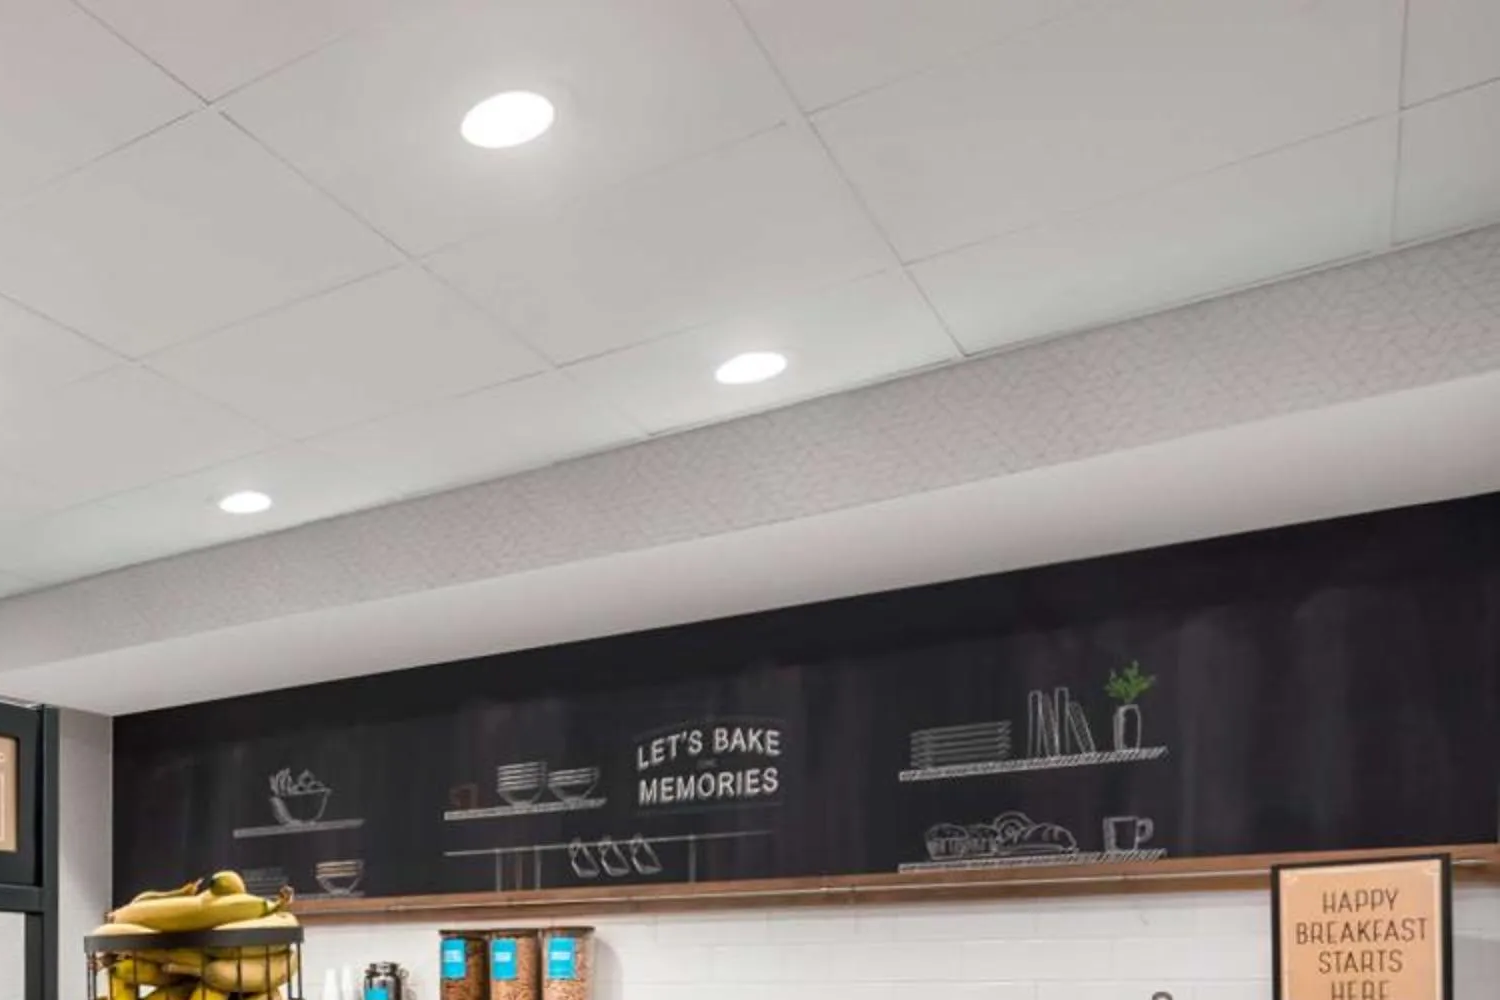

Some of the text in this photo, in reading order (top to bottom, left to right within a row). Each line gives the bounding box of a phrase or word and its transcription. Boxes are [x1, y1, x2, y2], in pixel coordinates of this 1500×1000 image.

[637, 727, 782, 771] LET'S BAKE
[638, 767, 779, 806] MEMORIES
[1322, 888, 1399, 914] HAPPY
[1296, 917, 1428, 945] BREAKFAST
[1318, 949, 1403, 974] STARTS
